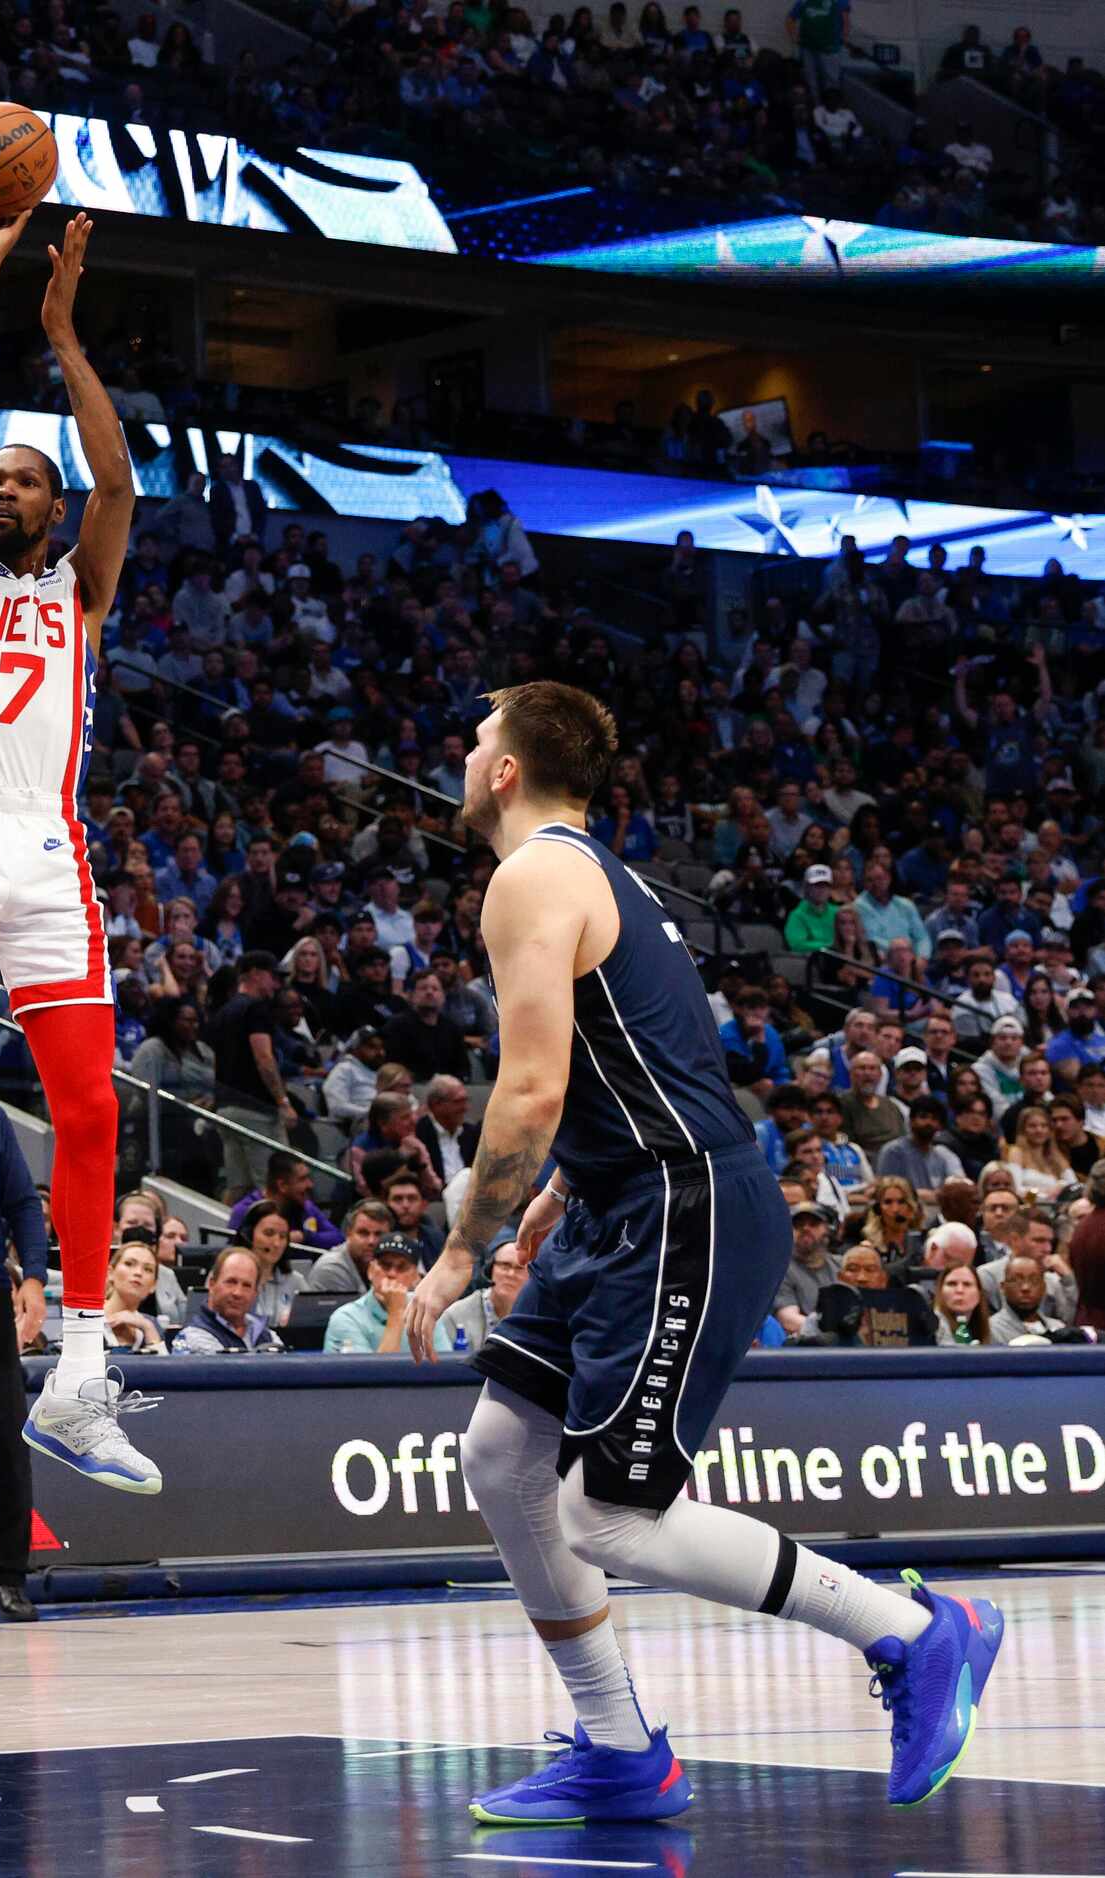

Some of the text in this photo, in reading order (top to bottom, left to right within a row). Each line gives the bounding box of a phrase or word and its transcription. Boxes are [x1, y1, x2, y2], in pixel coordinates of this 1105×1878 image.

[38, 577, 63, 588] Webull
[682, 1426, 843, 1503] rline
[861, 1421, 926, 1498] of
[940, 1421, 1048, 1497] the
